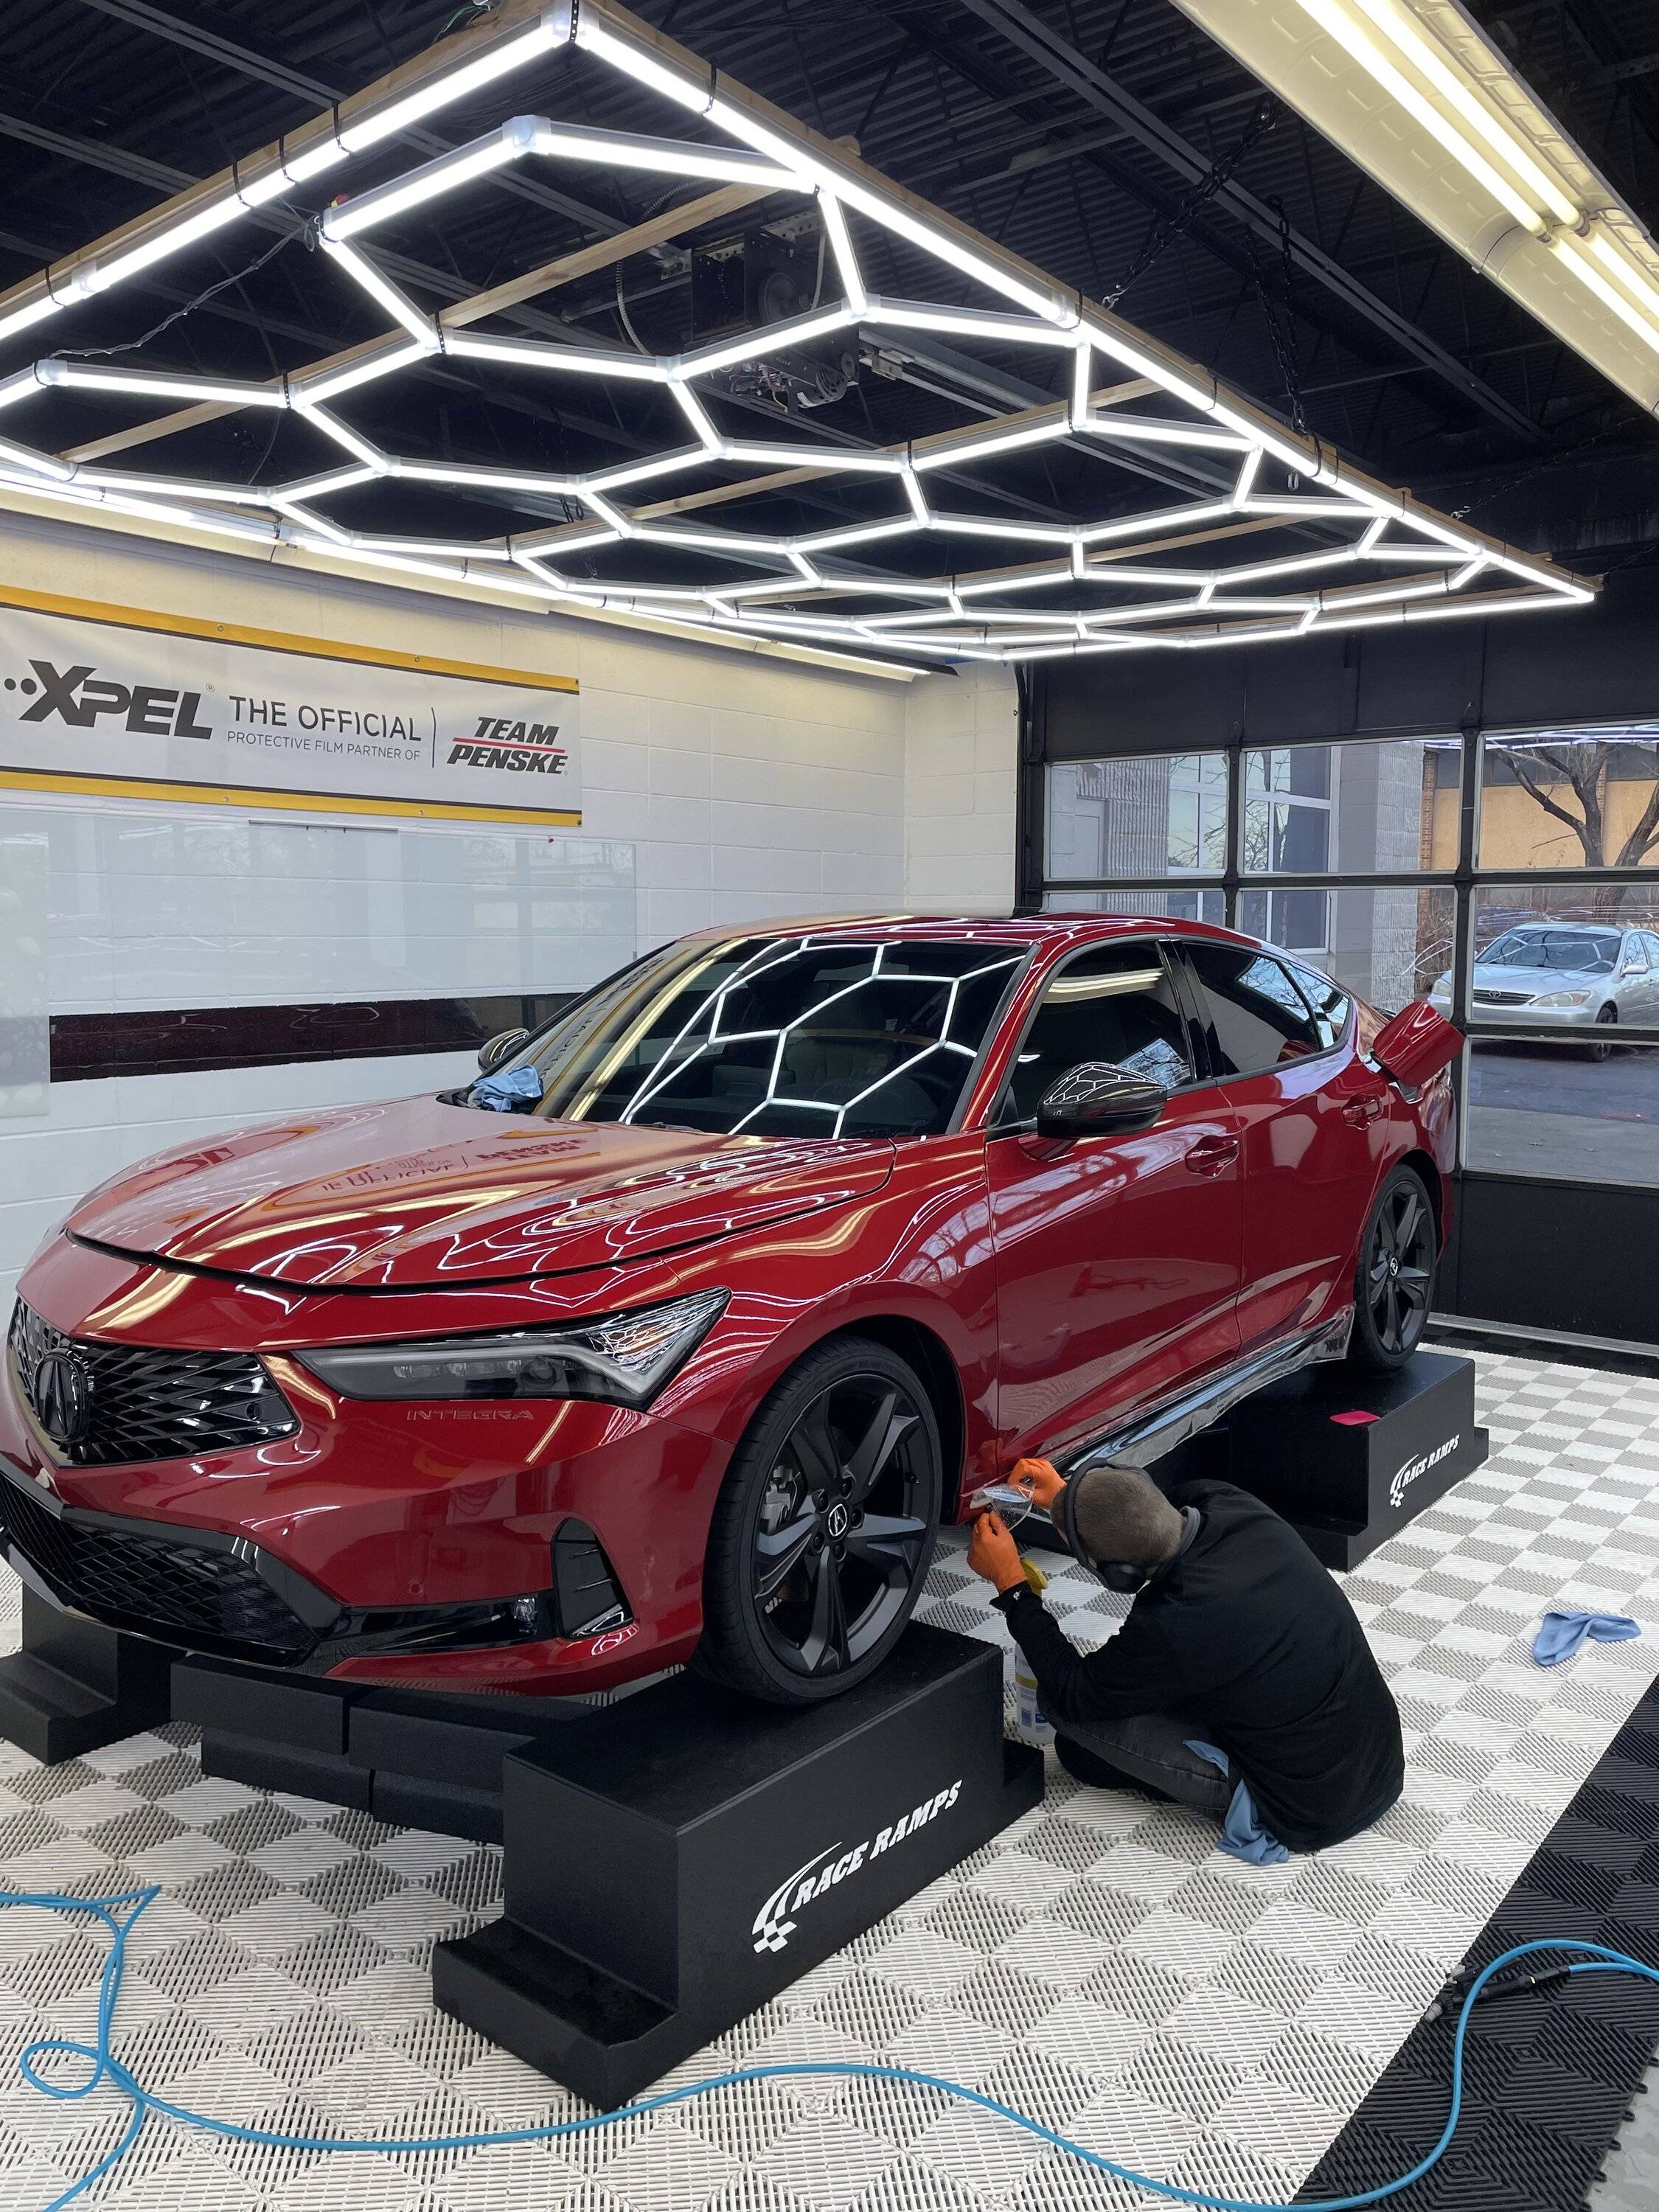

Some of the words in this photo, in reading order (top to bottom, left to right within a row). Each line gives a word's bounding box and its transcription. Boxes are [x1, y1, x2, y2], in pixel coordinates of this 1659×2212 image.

[229, 695, 287, 726] THE
[298, 705, 422, 742] OFFICIAL
[474, 717, 560, 745] TEAM
[227, 731, 311, 751] PROTECTIVE
[315, 740, 343, 754] FILM
[347, 743, 401, 759] PARTNER
[405, 749, 420, 761] OF
[447, 744, 568, 774] PENSKE
[406, 1409, 535, 1421] INTEGRA
[1402, 1457, 1427, 1488] RACE
[1427, 1434, 1460, 1469] RAMPS
[790, 1841, 869, 1913] RACE
[869, 1779, 962, 1860] RAMPS
